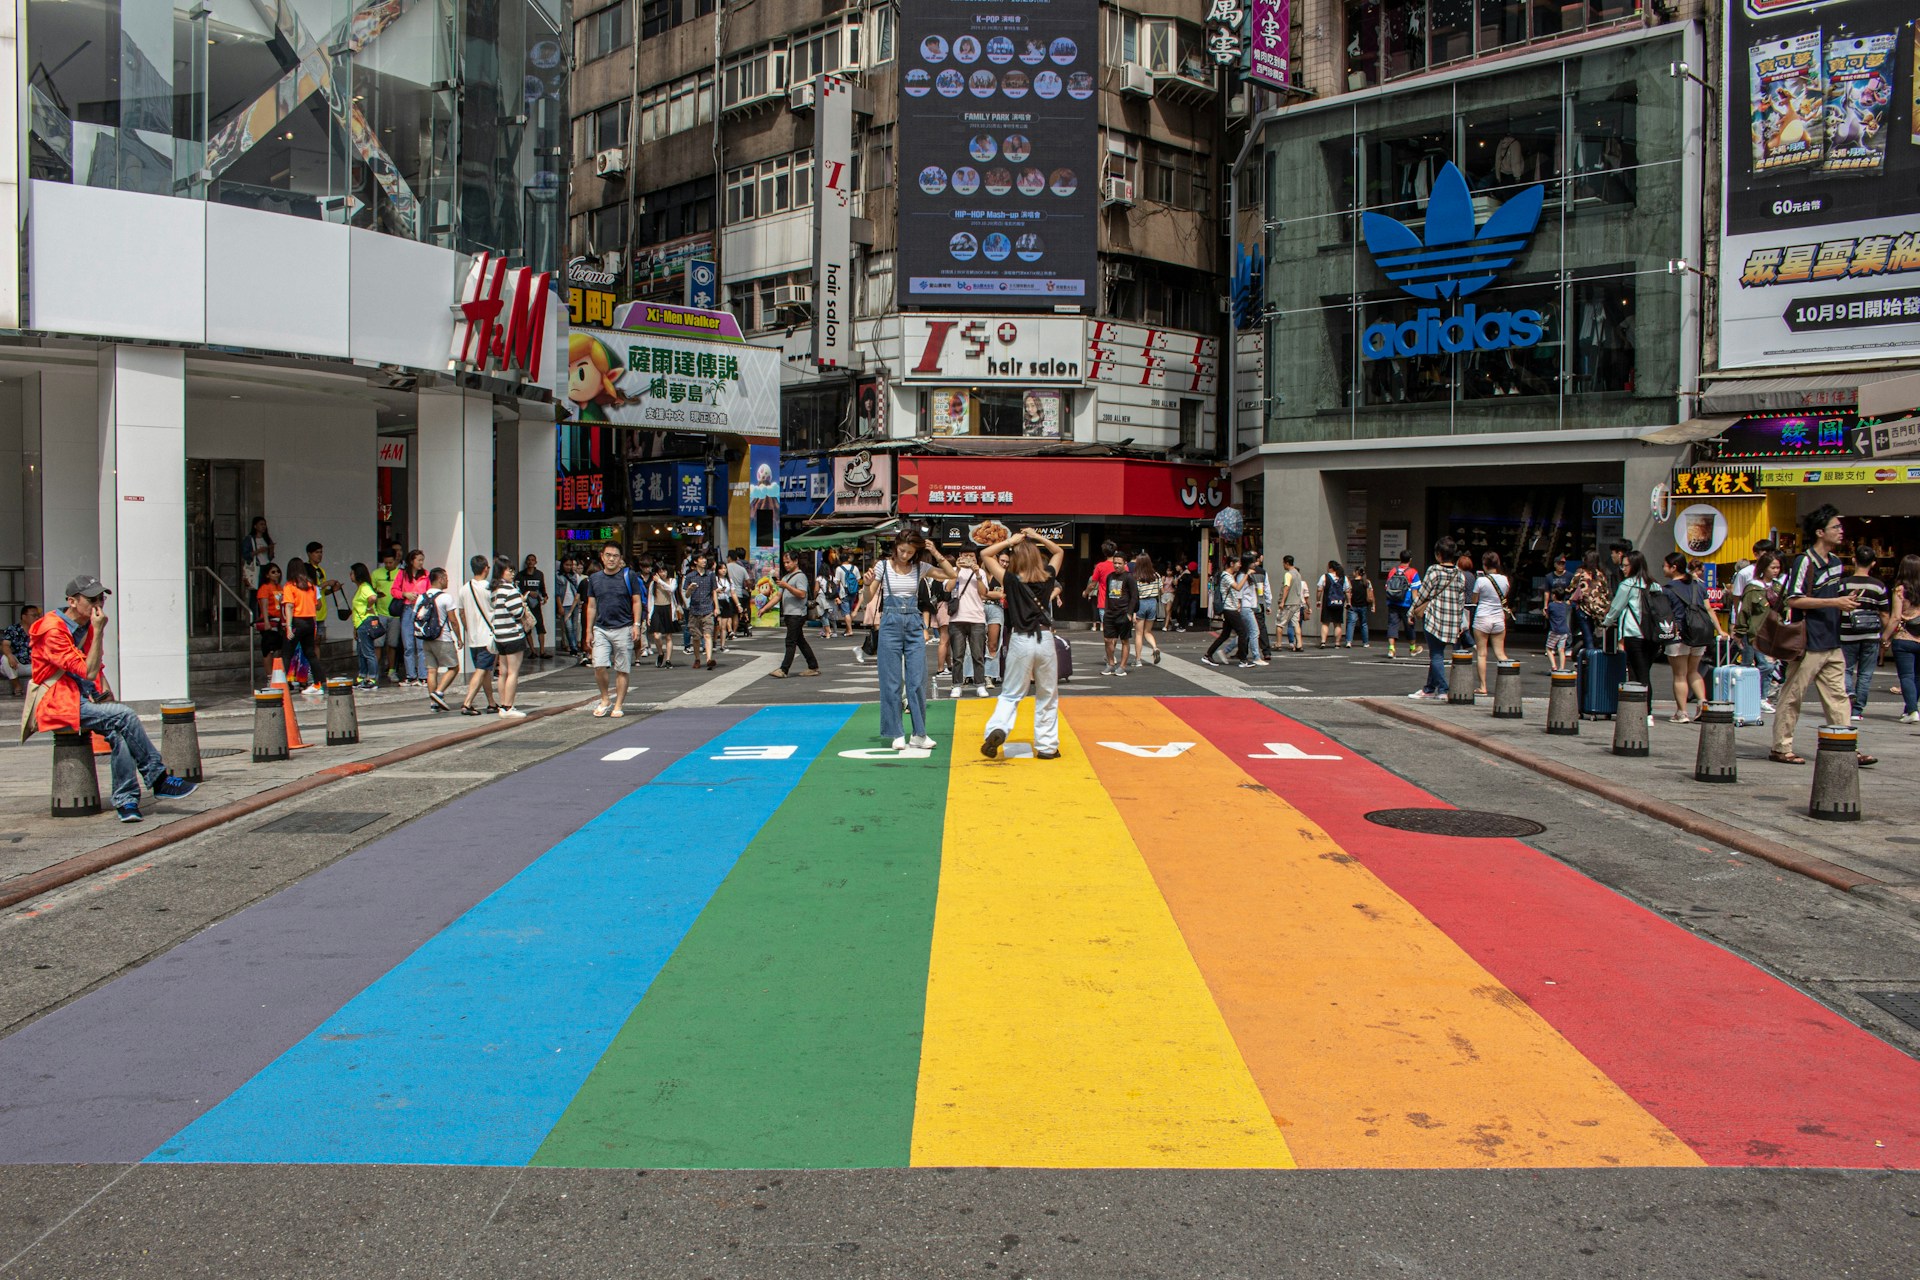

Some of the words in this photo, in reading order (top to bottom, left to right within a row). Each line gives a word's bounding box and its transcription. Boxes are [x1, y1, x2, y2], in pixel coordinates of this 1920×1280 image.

[976, 15, 999, 23] K-POP
[964, 112, 990, 121] FAMILY
[991, 113, 1010, 121] PARK
[954, 210, 985, 218] HIP-HOP
[986, 210, 1019, 219] Mash-up
[1772, 199, 1821, 215] 60元台幣
[827, 263, 841, 297] hair
[461, 251, 550, 383] H&M
[647, 307, 683, 325] Xi-Men
[684, 313, 720, 329] Walker
[826, 300, 840, 348] salon
[1362, 303, 1544, 360] adidas
[988, 357, 1023, 376] hair
[1030, 358, 1078, 377] salon
[650, 378, 703, 403] 織夢島
[645, 407, 685, 422] 支援中文
[380, 443, 404, 461] H&M
[632, 472, 672, 501] 雪龍
[1676, 471, 1752, 494] 黑堂佬大
[1824, 471, 1865, 481] 銀聯支付
[1182, 478, 1223, 507] J&G
[1592, 498, 1624, 515] OPEN
